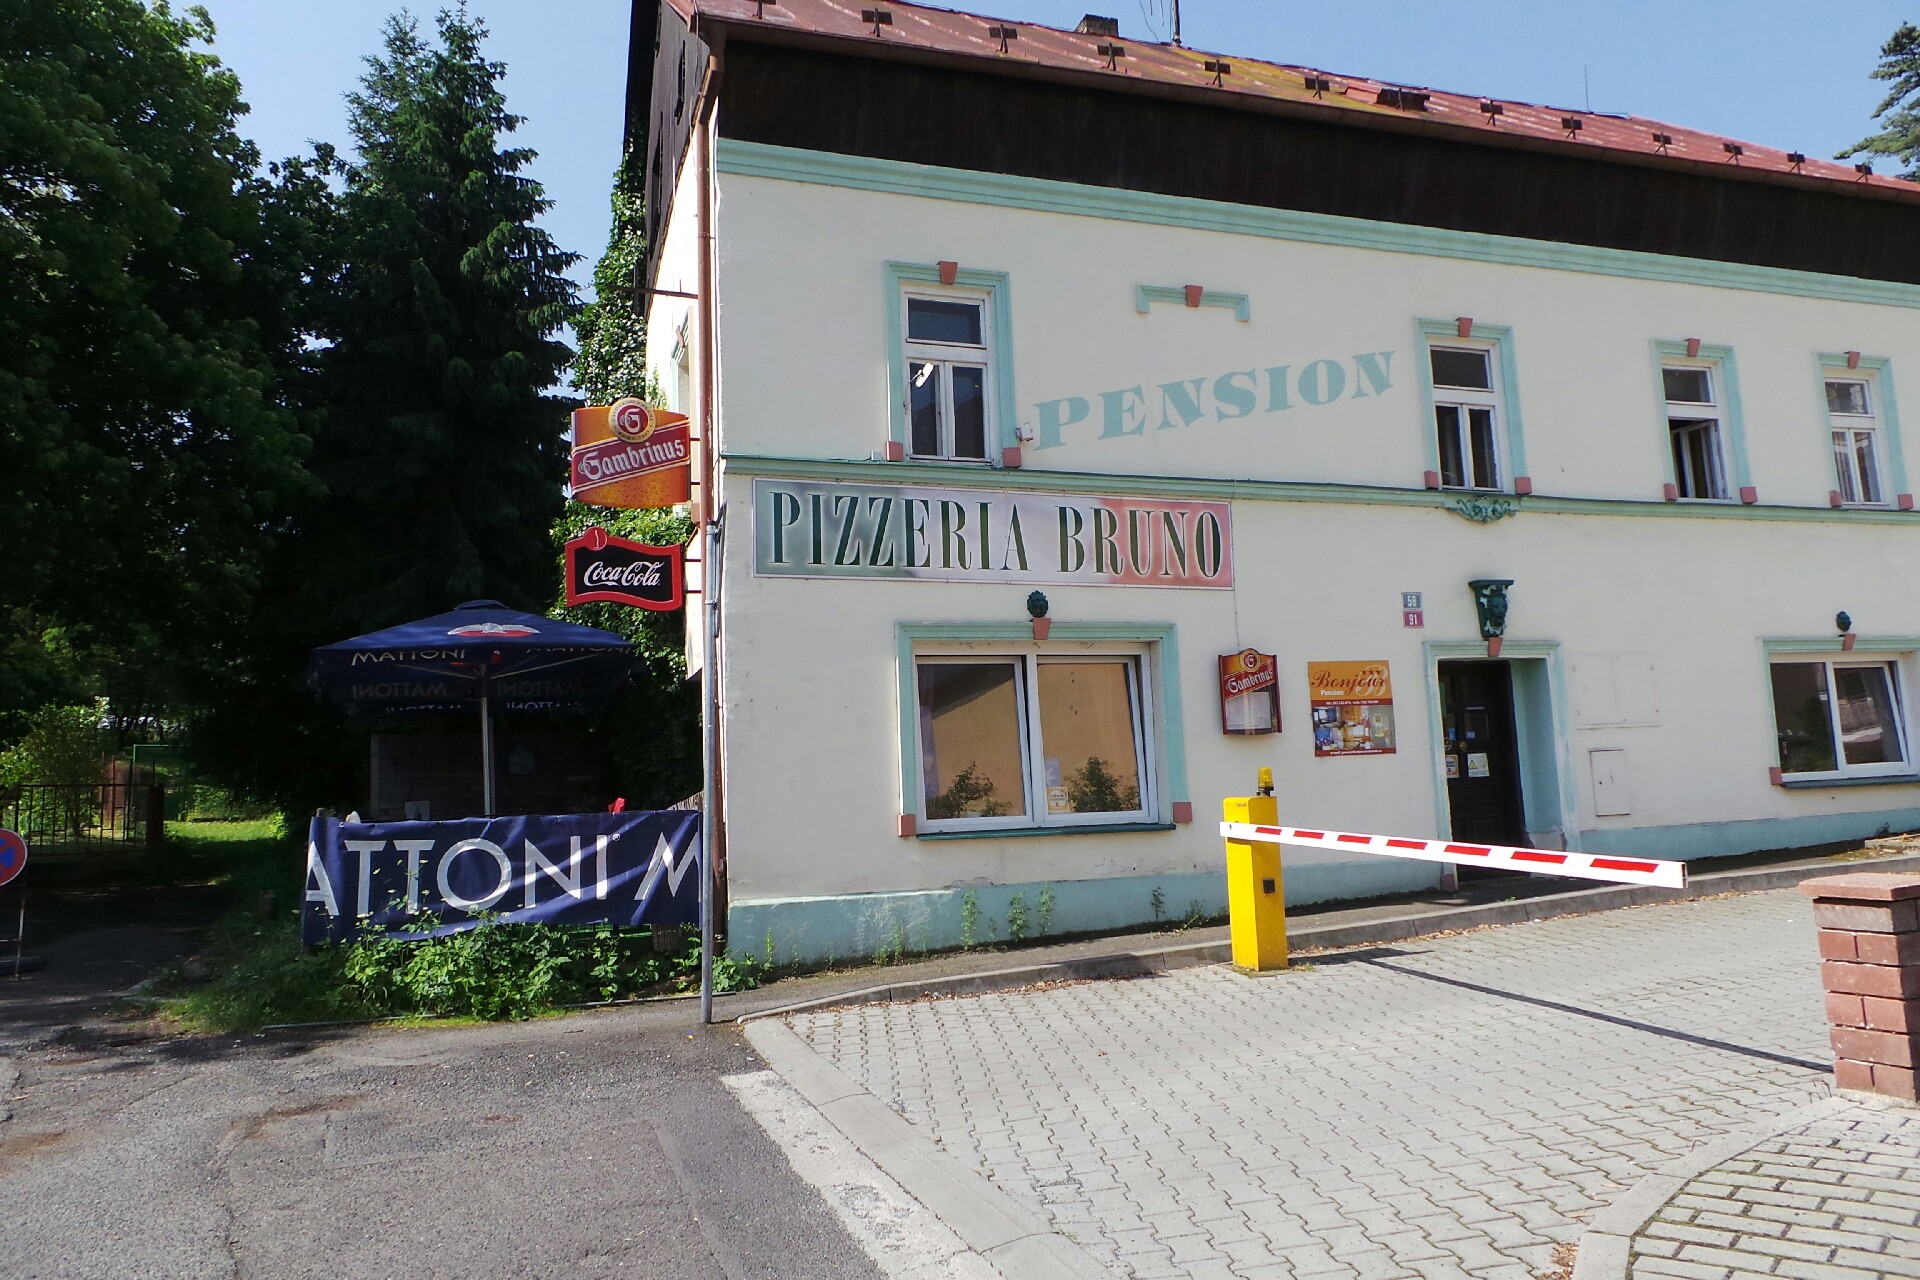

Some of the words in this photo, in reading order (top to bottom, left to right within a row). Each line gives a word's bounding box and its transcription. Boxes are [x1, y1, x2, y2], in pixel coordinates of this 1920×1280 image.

[1034, 350, 1397, 451] PENSION
[578, 439, 686, 480] Gambrinus
[769, 491, 1031, 572] PIZZERIA
[1054, 505, 1222, 578] BRUNO
[583, 561, 665, 587] Coca-Cola
[1408, 613, 1418, 626] 91
[1226, 669, 1274, 693] Gambrinus
[1311, 669, 1386, 696] Bonjour
[633, 831, 701, 901] M
